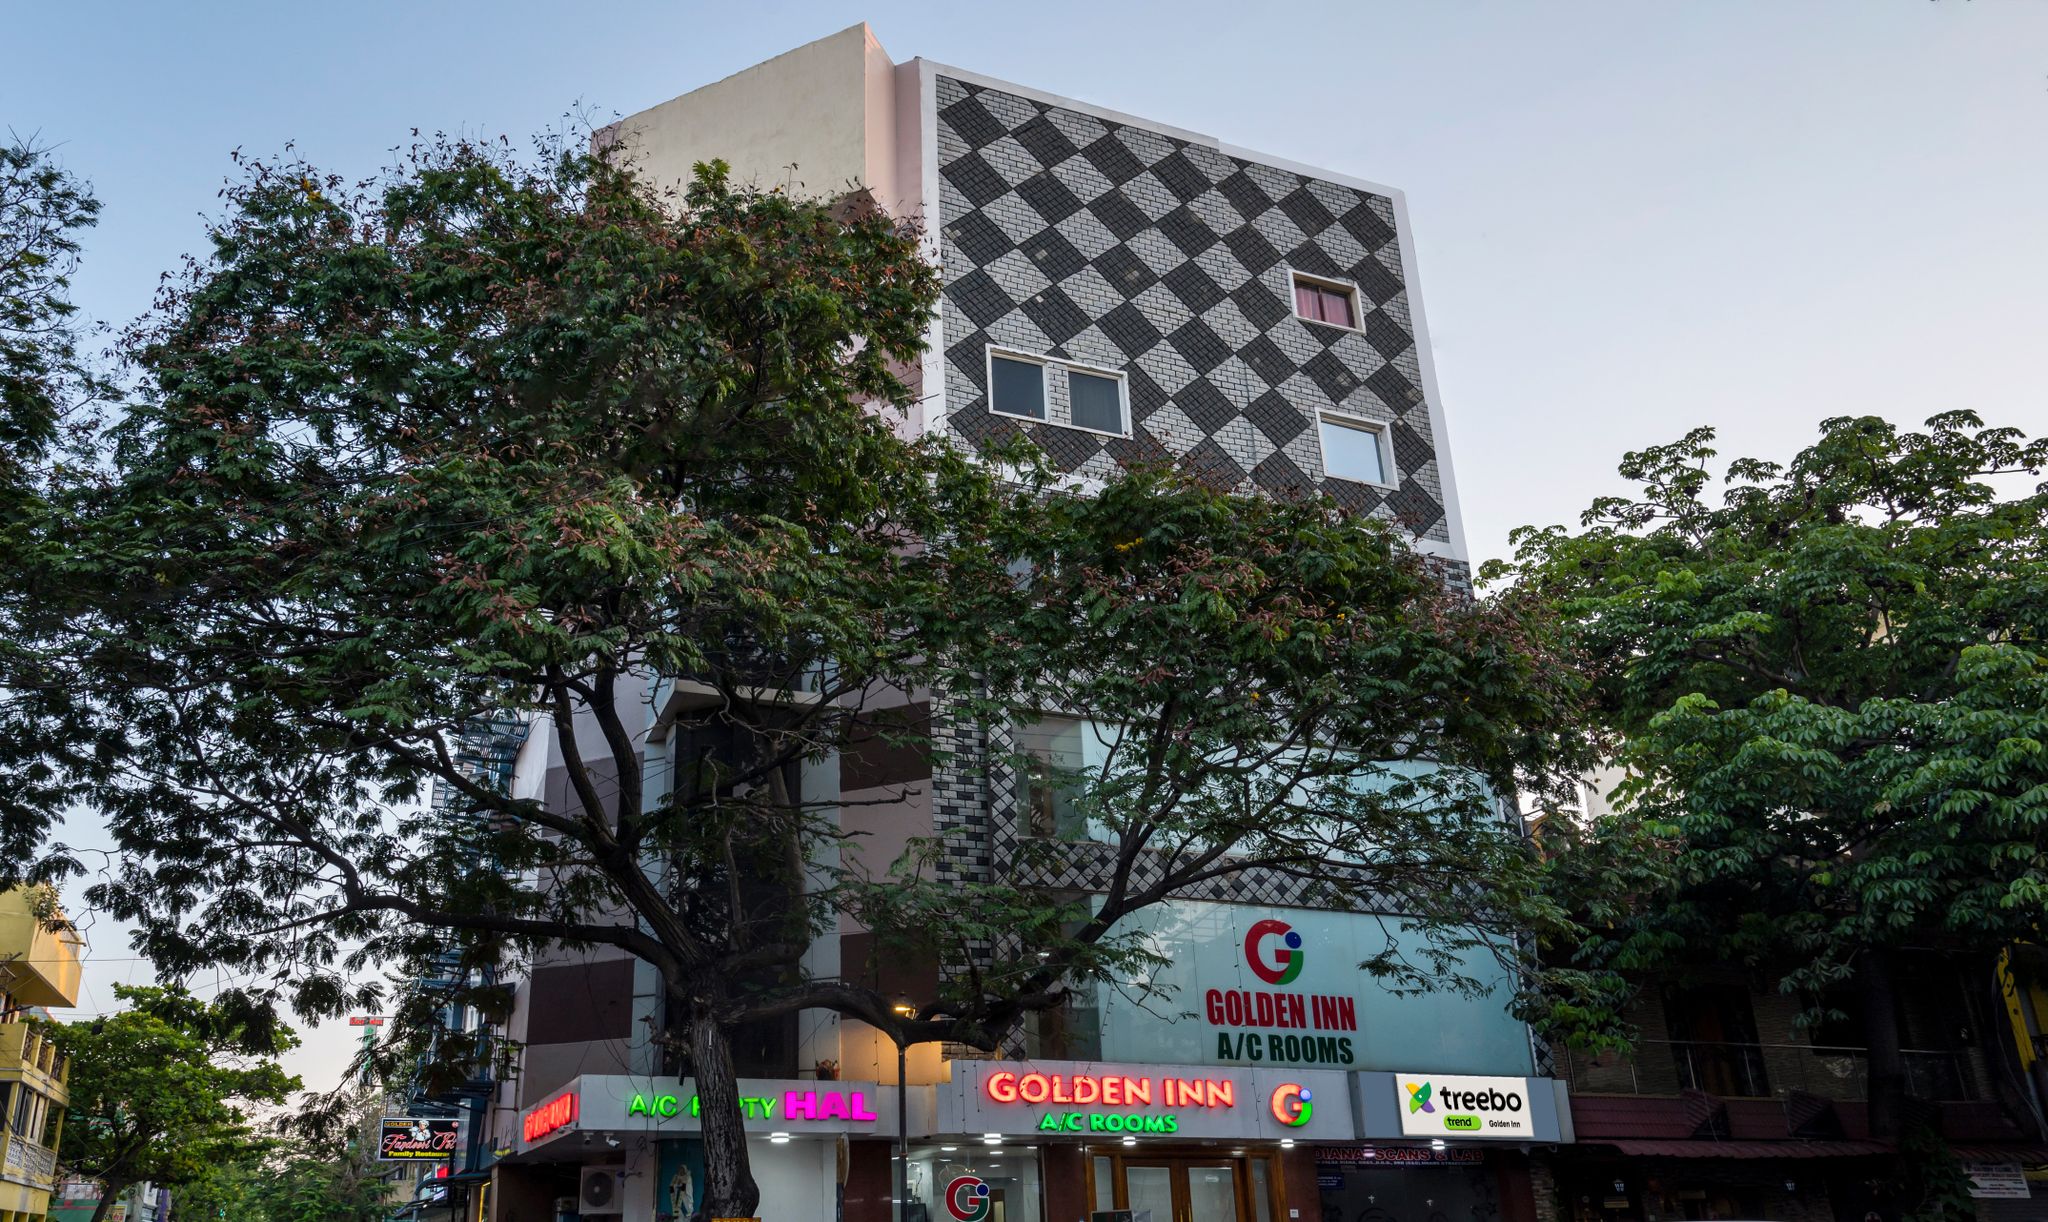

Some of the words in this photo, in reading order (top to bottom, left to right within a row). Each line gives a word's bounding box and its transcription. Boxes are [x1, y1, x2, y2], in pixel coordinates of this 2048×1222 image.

[1206, 988, 1307, 1029] GOLDEN
[1311, 995, 1357, 1031] INN
[1217, 1032, 1263, 1061] A/C
[1268, 1035, 1354, 1065] ROOMS
[987, 1071, 1152, 1105] GOLDEN
[1163, 1078, 1234, 1108] INN
[1439, 1086, 1523, 1113] treebo
[629, 1094, 678, 1117] A/C
[785, 1091, 877, 1121] HAL
[1039, 1112, 1083, 1132] A/C
[1089, 1113, 1179, 1134] ROOMS
[1447, 1117, 1472, 1127] trend
[1488, 1119, 1510, 1128] Golden
[1374, 1148, 1431, 1161] SCANS
[1435, 1149, 1447, 1161] &
[1450, 1149, 1485, 1161] LAB
